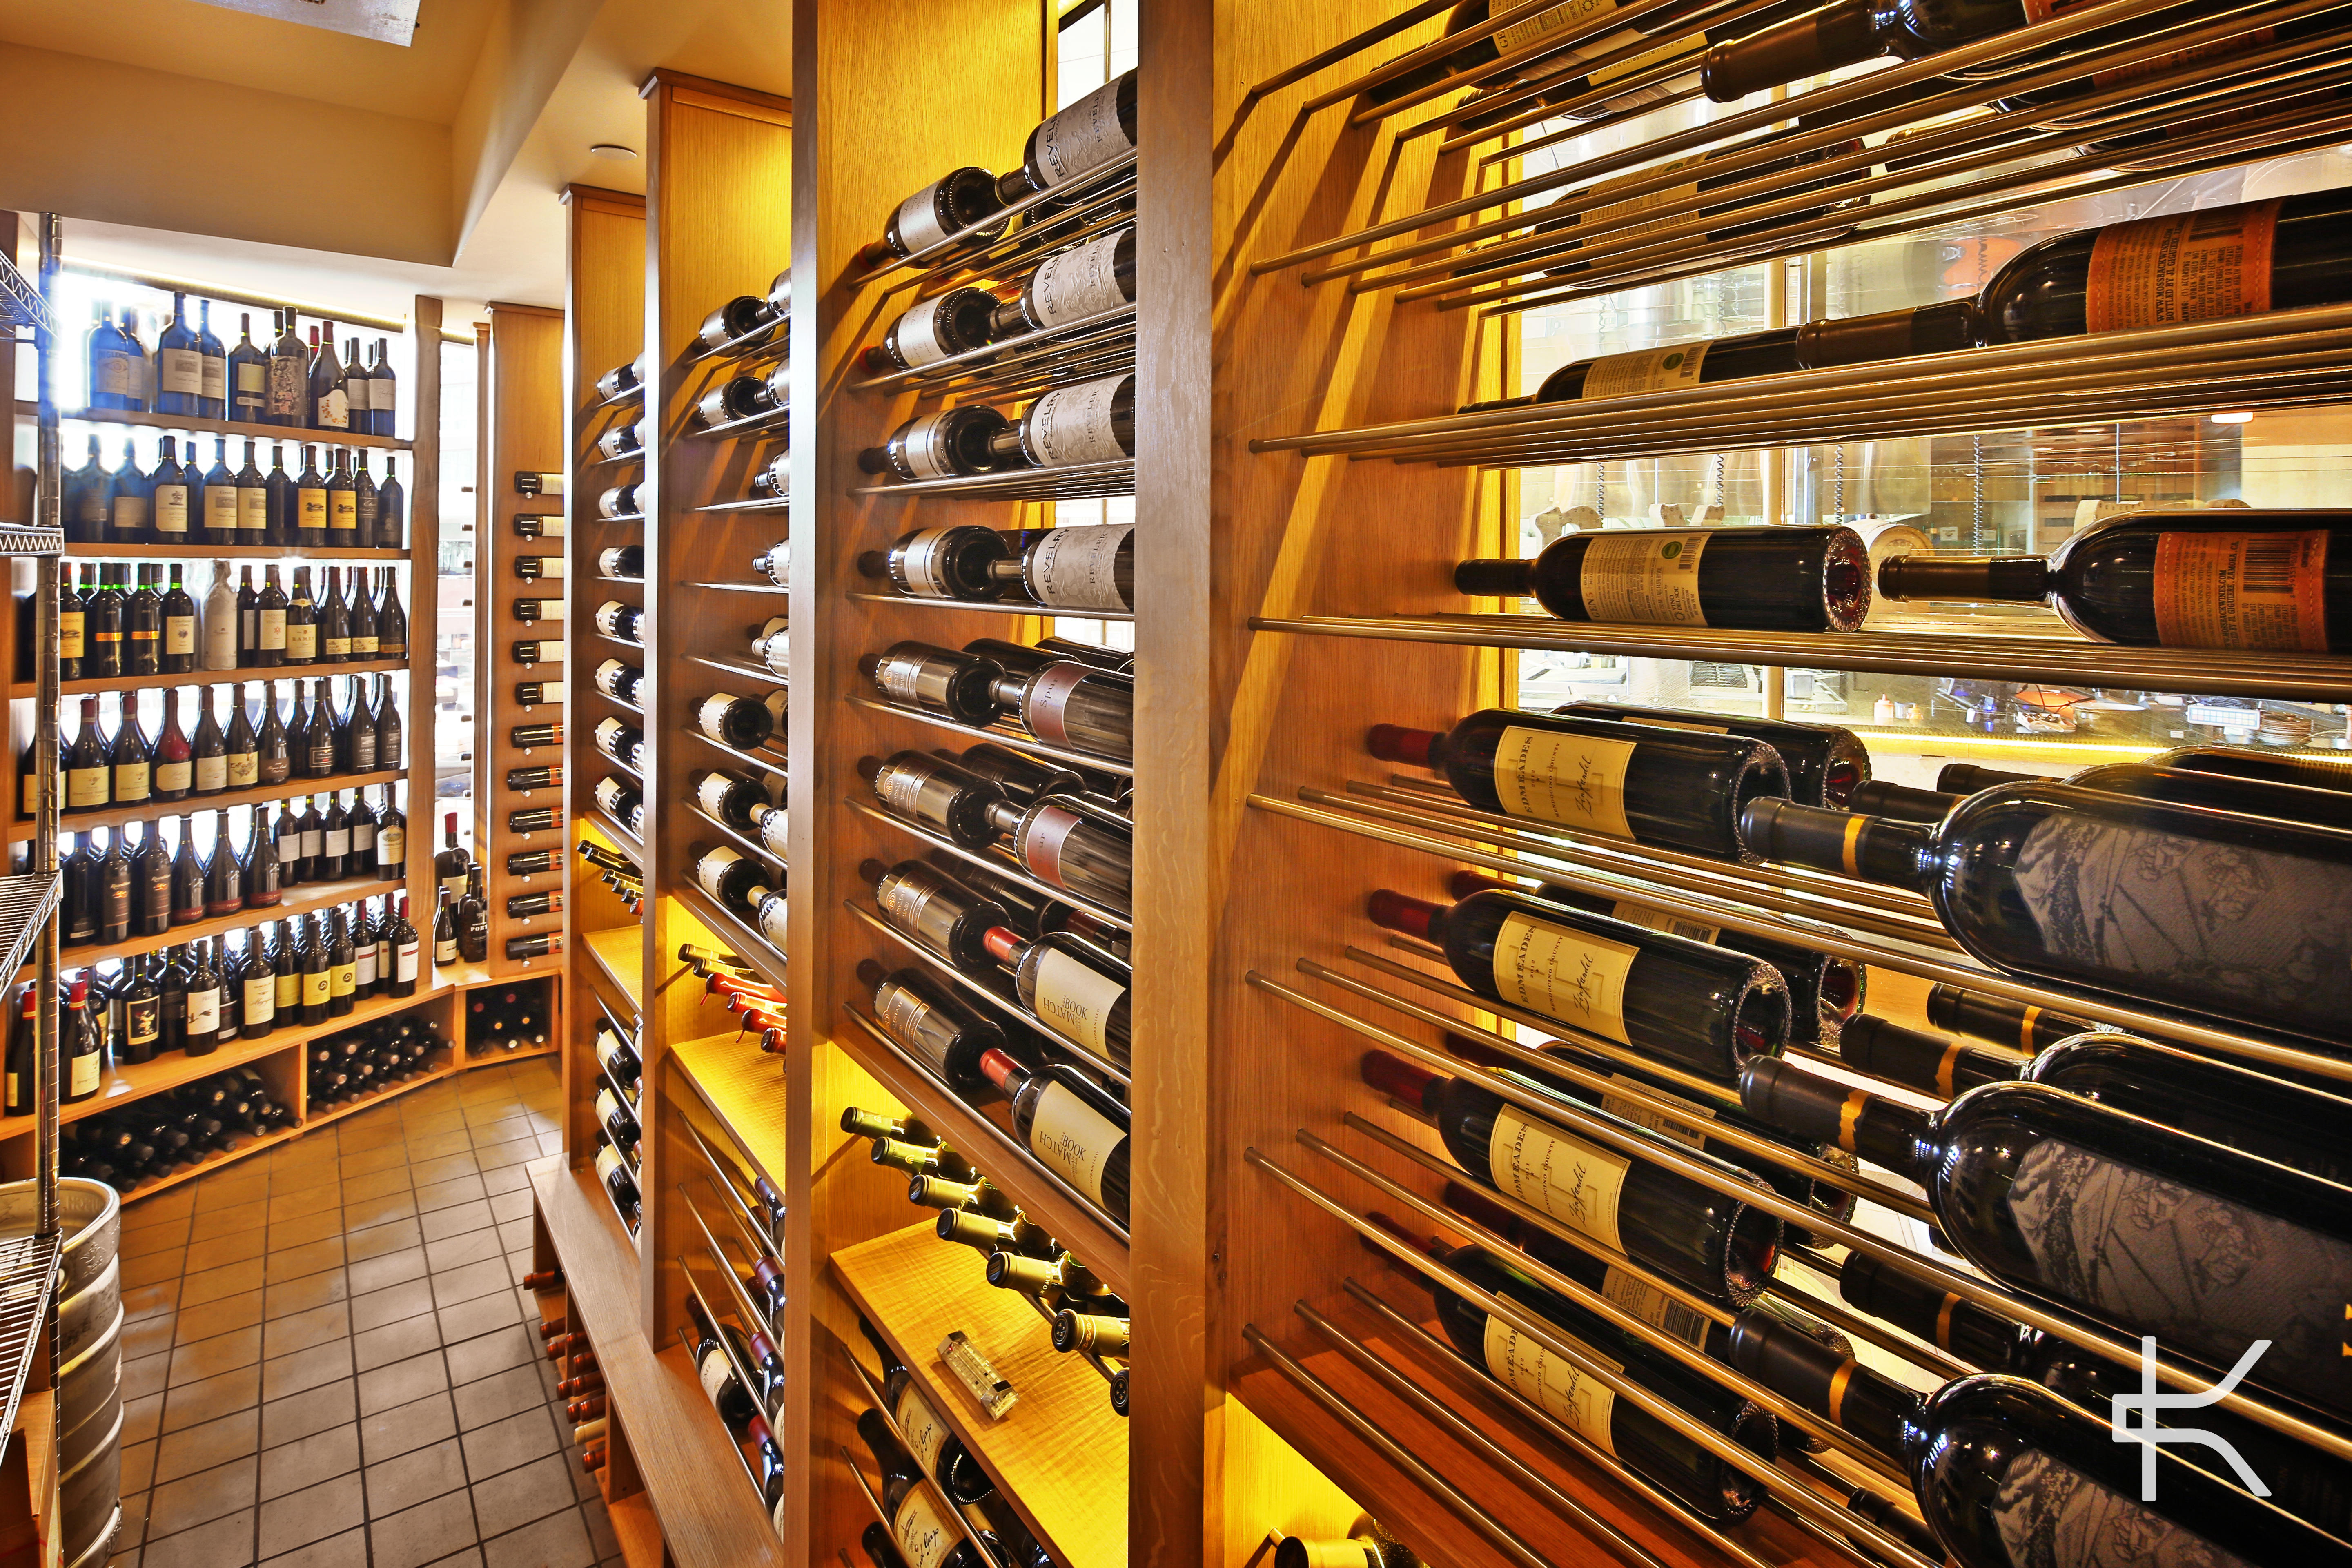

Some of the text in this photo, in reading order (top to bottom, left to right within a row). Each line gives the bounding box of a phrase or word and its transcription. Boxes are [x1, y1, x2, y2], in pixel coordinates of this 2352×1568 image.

[2200, 249, 2209, 274] PREGNANCY
[2217, 247, 2226, 263] IMPAIRS
[2226, 245, 2235, 266] OPERATE
[2165, 278, 2174, 287] BY
[2234, 268, 2242, 285] HEALTH
[2165, 290, 2174, 321] BOTTLED
[1042, 392, 1062, 460] REVELRY
[1043, 528, 1069, 594] REVELRY
[1040, 677, 1059, 708] Spur
[1517, 736, 1533, 813] EDMEADES
[1548, 742, 1560, 818] MENDOCINO COUNTY
[1575, 755, 1593, 819] Zinfandel
[1517, 925, 1537, 1004] EDMEADES
[1547, 935, 1563, 1012] MENDOCINO COUNTY
[1573, 952, 1593, 1019] Zinfandel
[1043, 997, 1075, 1026] MATCH
[1065, 998, 1088, 1020] BOOK
[1039, 1131, 1071, 1165] MATCH
[1062, 1135, 1086, 1161] BOOK
[1542, 1138, 1556, 1171] COUNTY
[1568, 1161, 1587, 1227] Zinfandel
[1537, 1347, 1546, 1368] COUN
[923, 1528, 939, 1557] Gap
